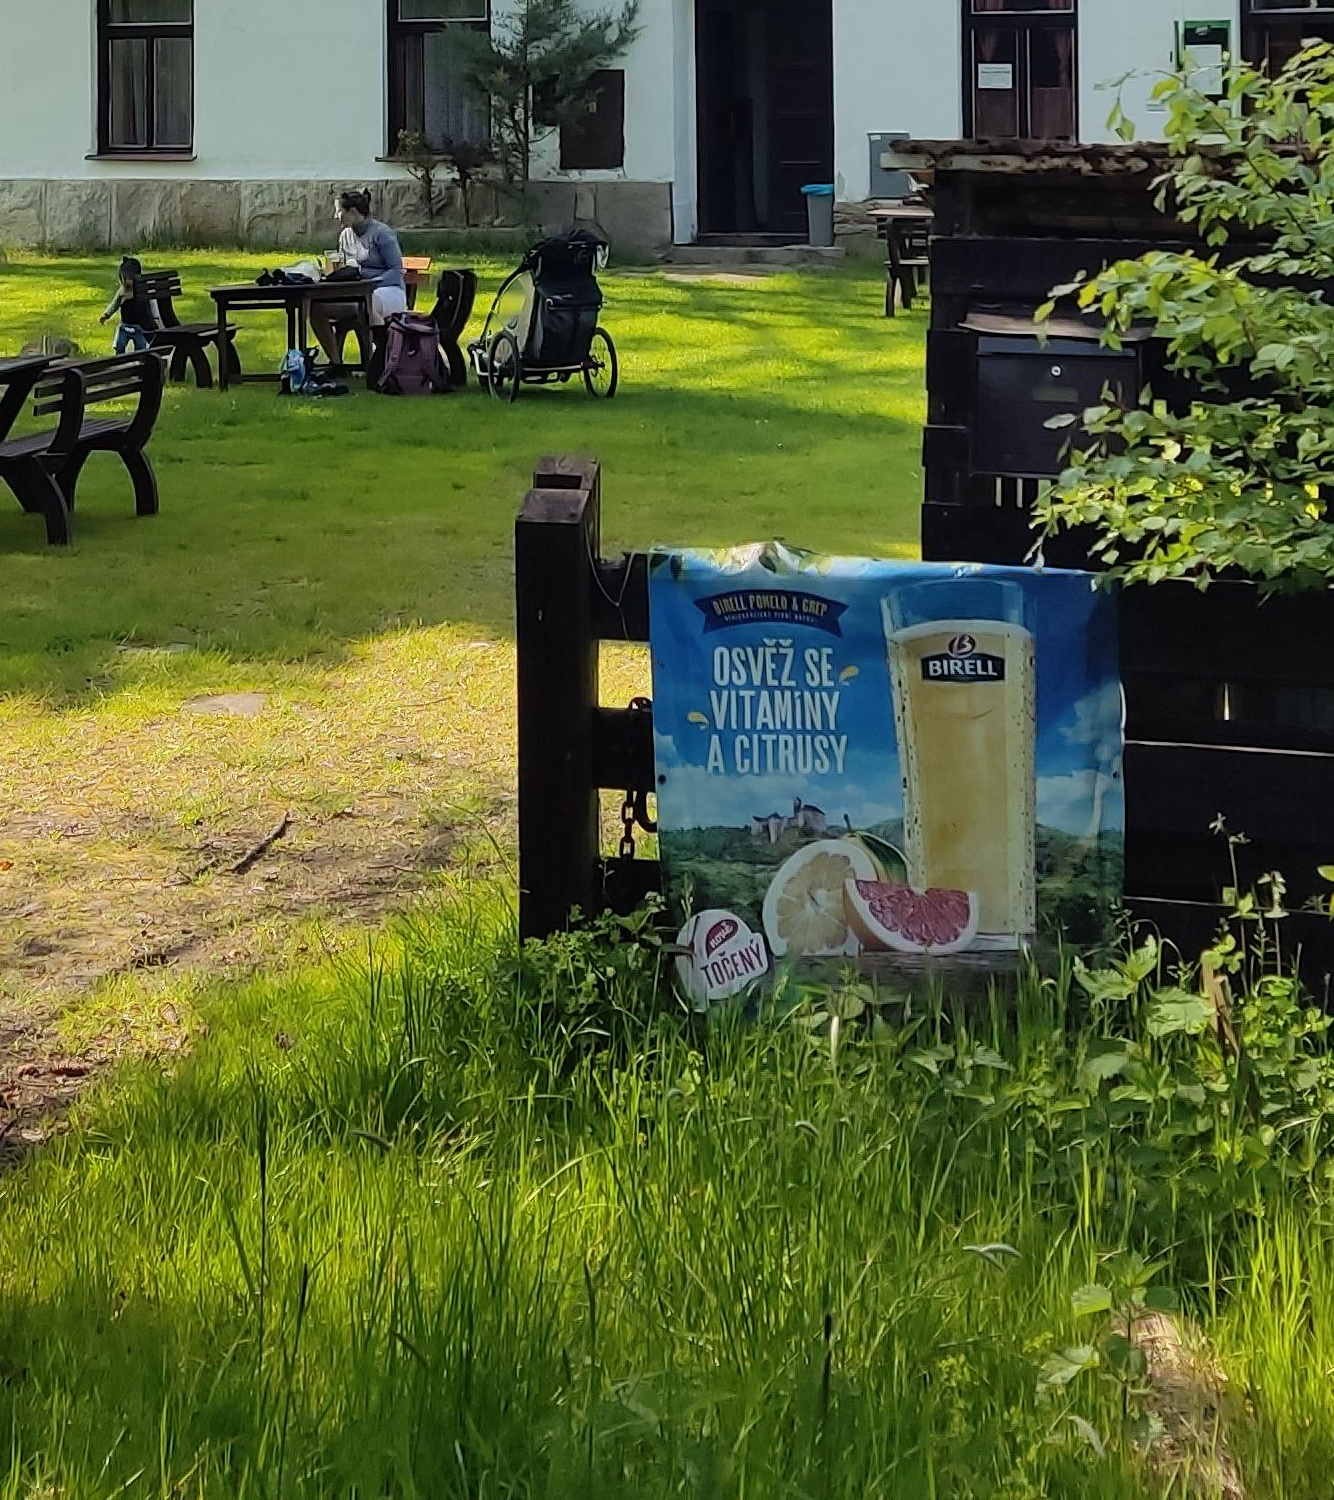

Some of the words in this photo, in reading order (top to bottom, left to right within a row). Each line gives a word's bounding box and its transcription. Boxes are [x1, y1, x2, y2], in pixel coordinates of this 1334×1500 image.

[712, 595, 747, 616] BIRELL
[749, 594, 788, 611] POMELO
[802, 598, 828, 617] GREP
[713, 638, 796, 687] OSVĚŽ
[804, 647, 835, 687] SE
[928, 659, 998, 677] BIRELL
[710, 690, 840, 731] VITAMÍNY
[707, 734, 726, 774] A
[734, 734, 848, 775] CITRUSY
[700, 939, 764, 989] TOČENÝ
